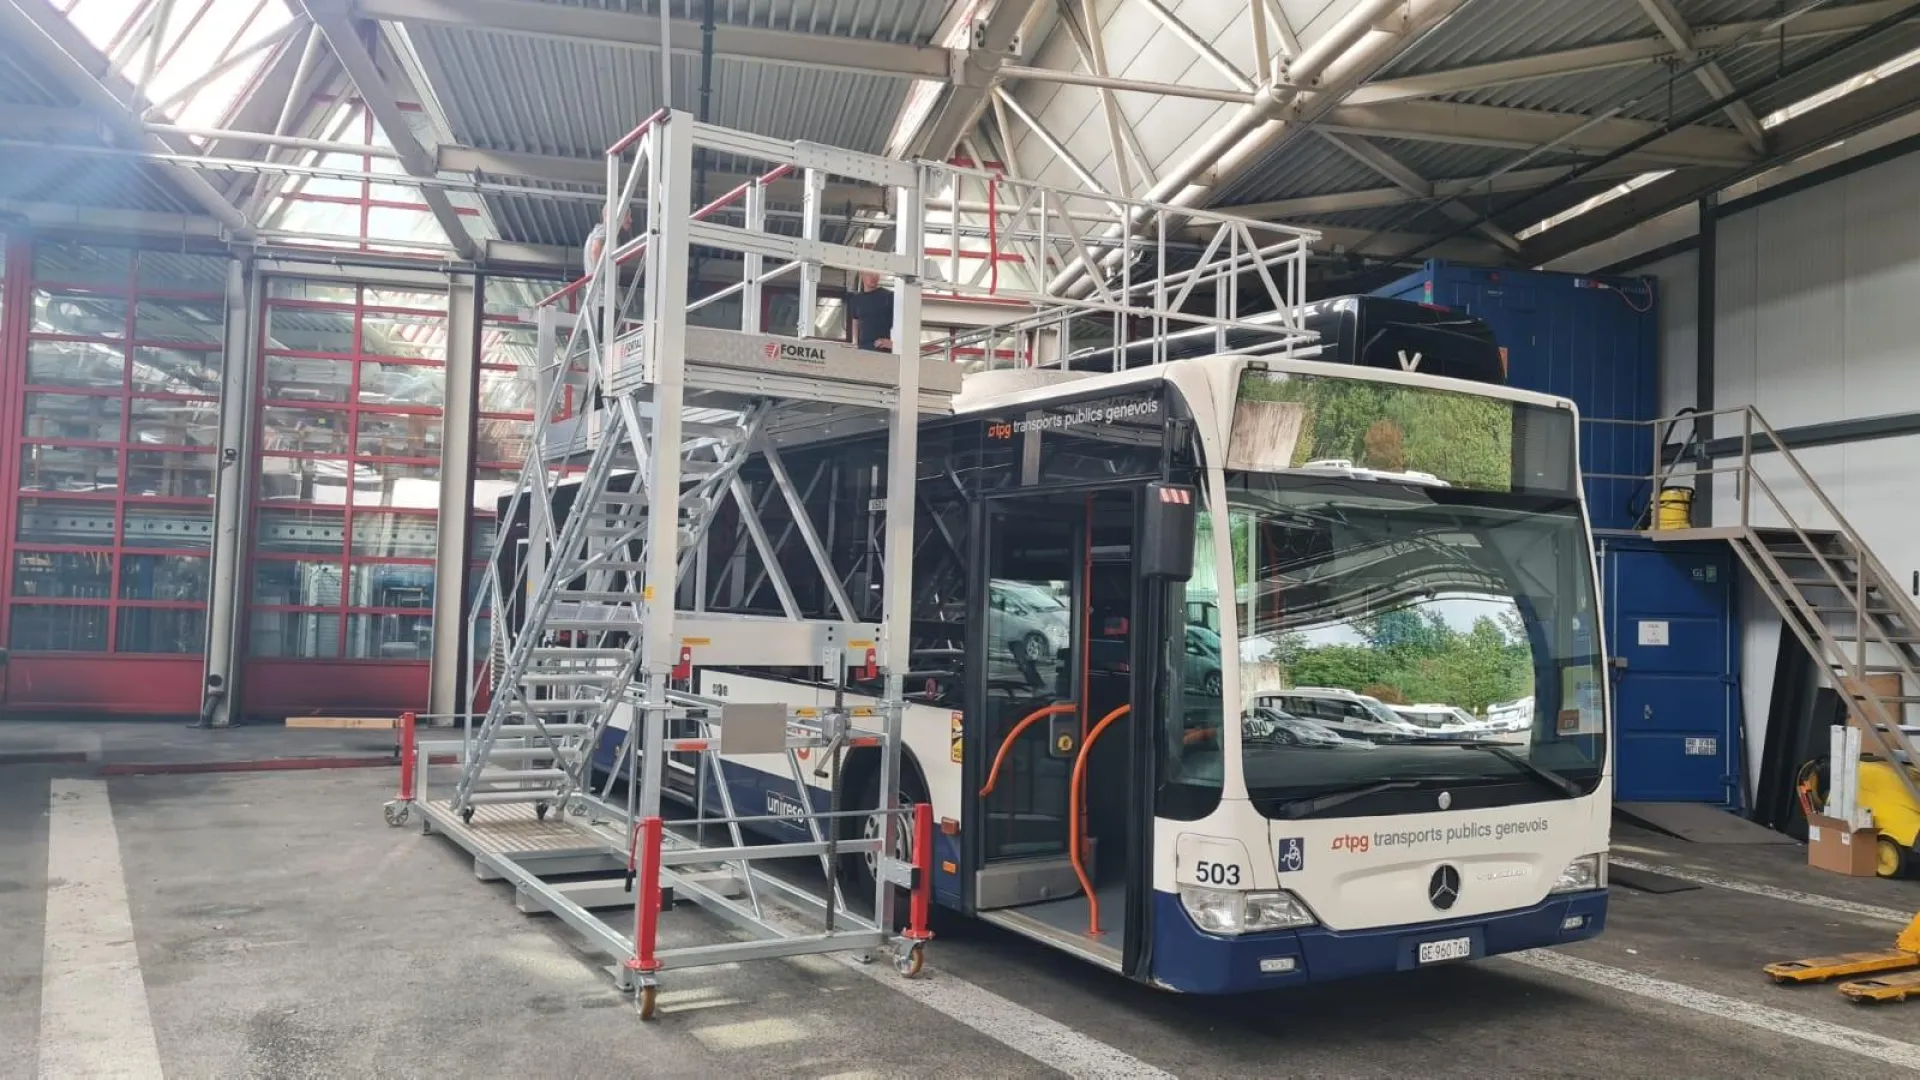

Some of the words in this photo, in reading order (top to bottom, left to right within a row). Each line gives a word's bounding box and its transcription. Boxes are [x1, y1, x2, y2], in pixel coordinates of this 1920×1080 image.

[780, 344, 826, 360] FORTAL
[1013, 415, 1063, 433] transports
[1064, 407, 1103, 430] publics
[1105, 399, 1158, 423] genevois
[1373, 827, 1443, 848] transports
[1446, 823, 1492, 844] publics
[1495, 817, 1548, 840] genevois
[1196, 860, 1240, 885] 503
